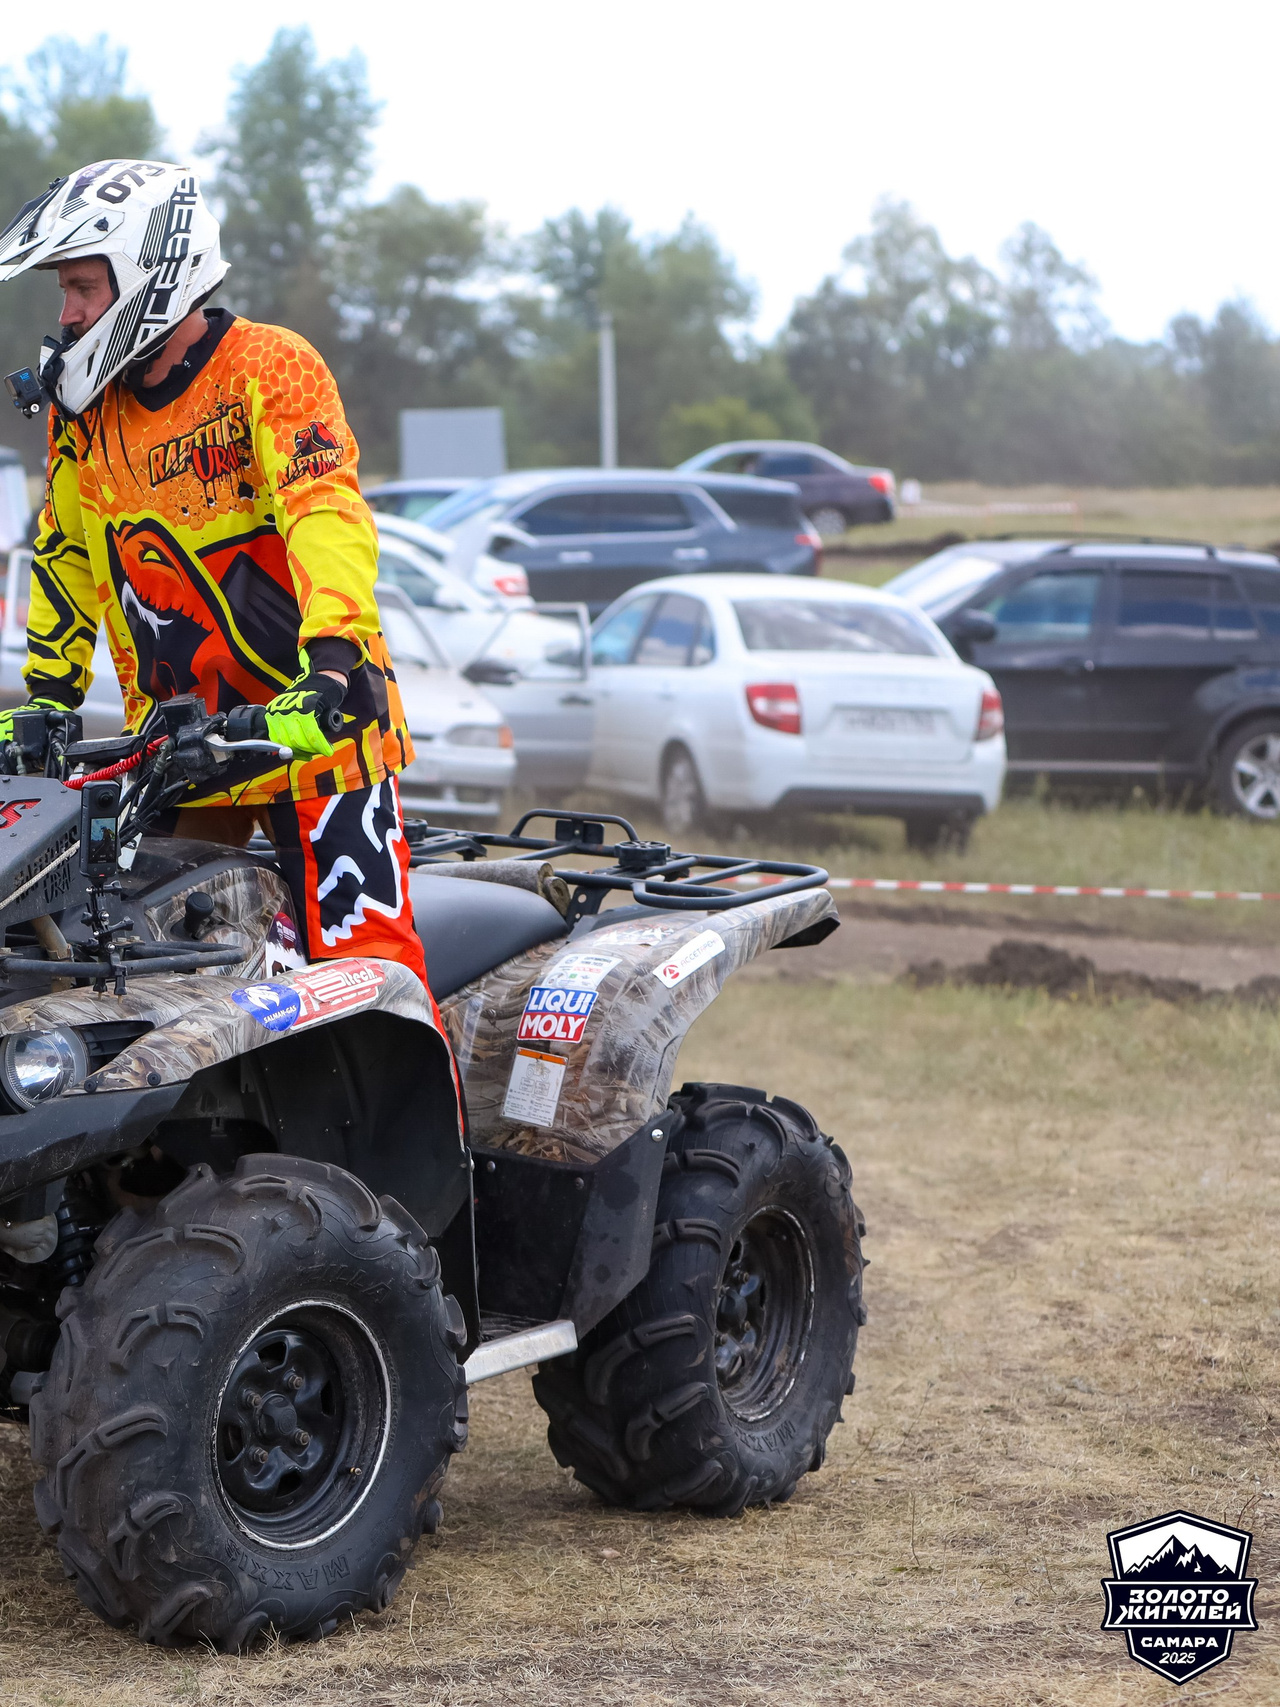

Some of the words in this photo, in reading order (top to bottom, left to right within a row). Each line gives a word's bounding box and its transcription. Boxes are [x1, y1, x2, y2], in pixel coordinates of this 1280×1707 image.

[263, 1005, 297, 1024] SALMAN-GAS
[527, 988, 595, 1015] LIQUI
[520, 1013, 586, 1040] MOLY
[225, 1537, 351, 1591] MAXXIS
